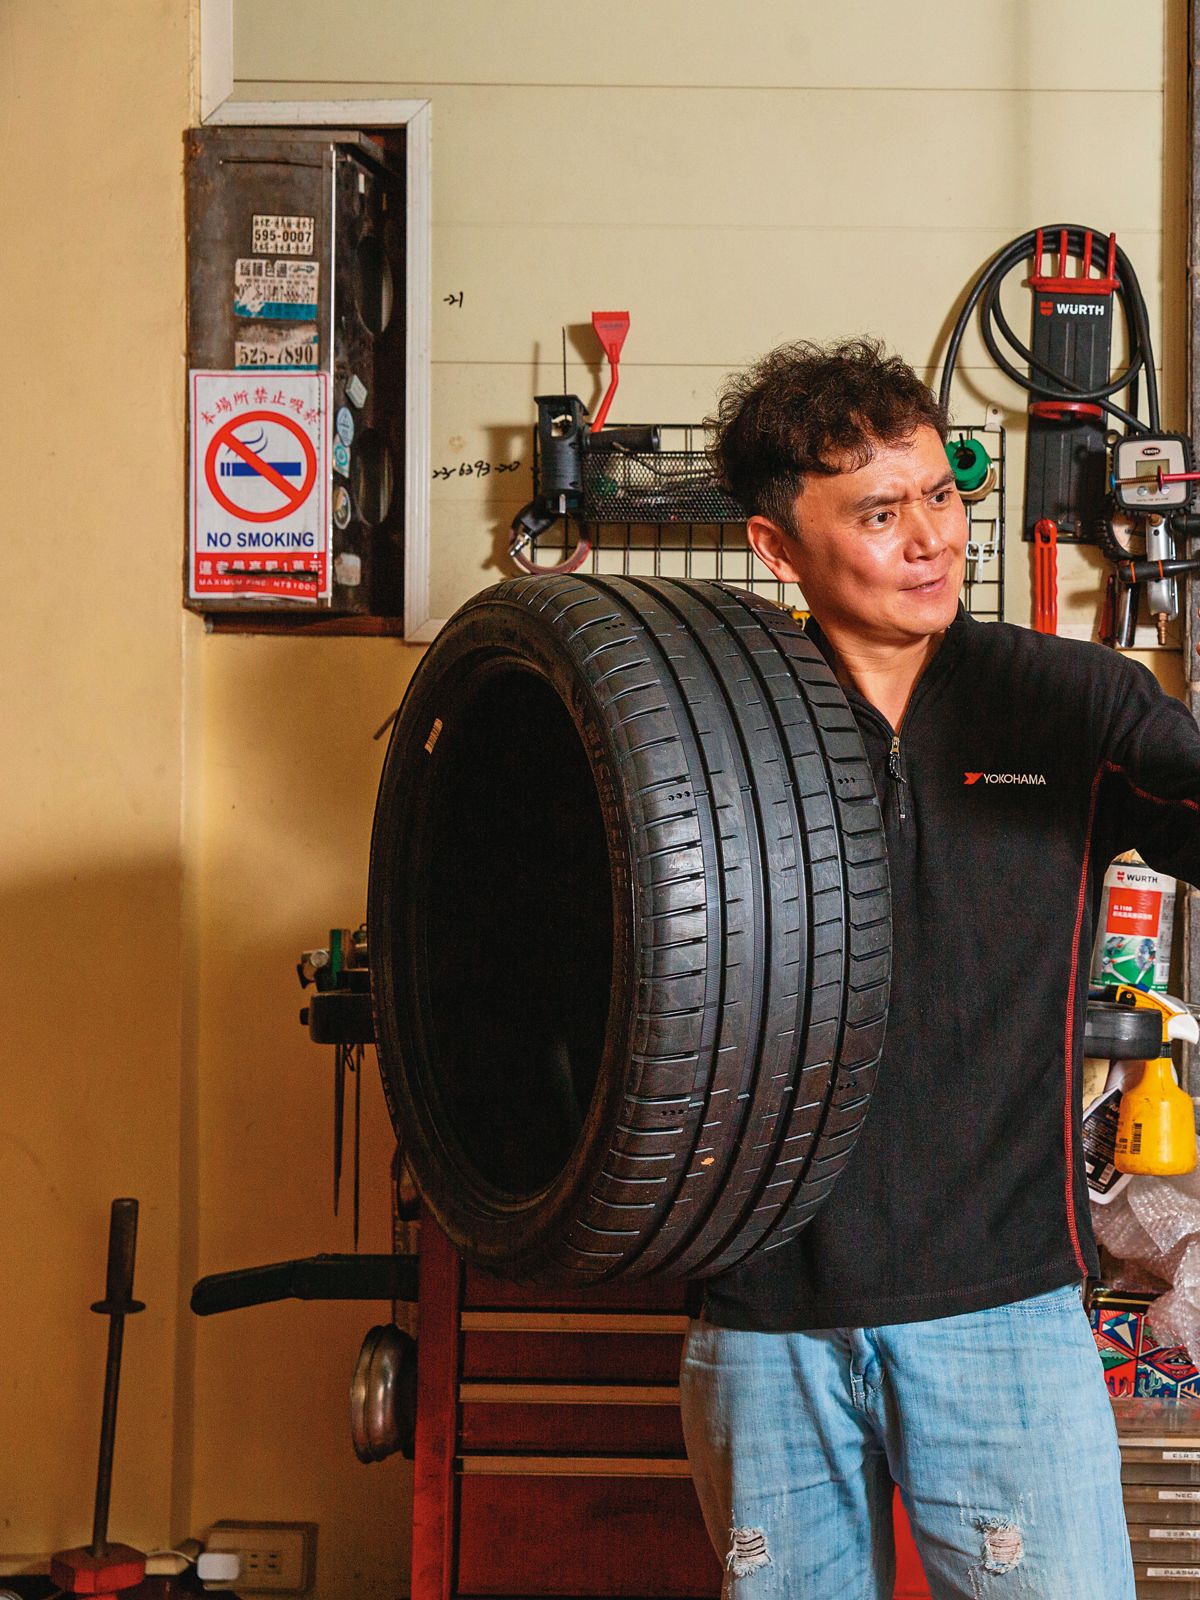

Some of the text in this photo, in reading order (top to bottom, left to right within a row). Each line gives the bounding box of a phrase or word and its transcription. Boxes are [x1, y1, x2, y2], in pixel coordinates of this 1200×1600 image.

[255, 229, 311, 242] 595-0007
[1056, 303, 1105, 316] WÜRTH
[240, 345, 313, 364] 525-7890
[207, 532, 315, 547] NO SMOKING
[983, 773, 1047, 785] YOKOHAMA
